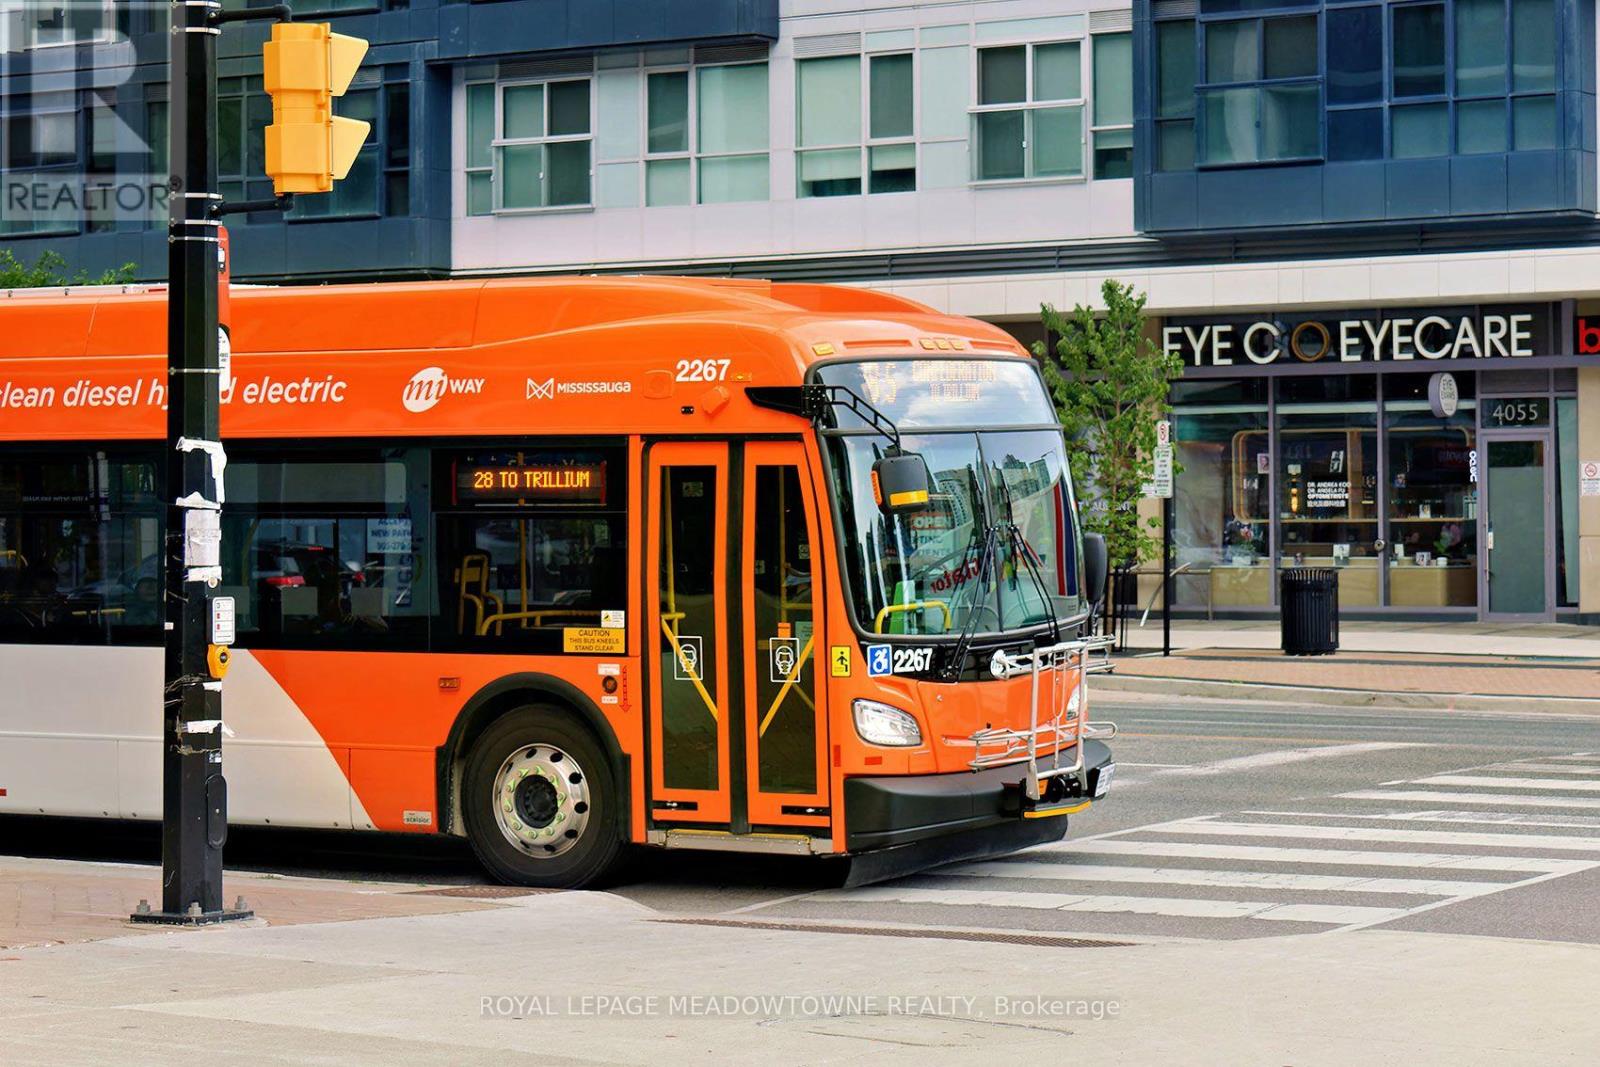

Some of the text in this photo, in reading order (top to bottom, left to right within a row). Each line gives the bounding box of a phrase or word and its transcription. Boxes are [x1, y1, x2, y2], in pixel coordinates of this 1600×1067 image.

[1340, 314, 1533, 362] EYECARE
[675, 359, 731, 382] 2267
[0, 381, 55, 408] lean
[63, 378, 143, 406] diesel
[242, 375, 347, 404] electric
[1493, 404, 1539, 421] 4055
[474, 471, 590, 488] 28 TO TRILLIUM
[893, 648, 933, 673] 2267
